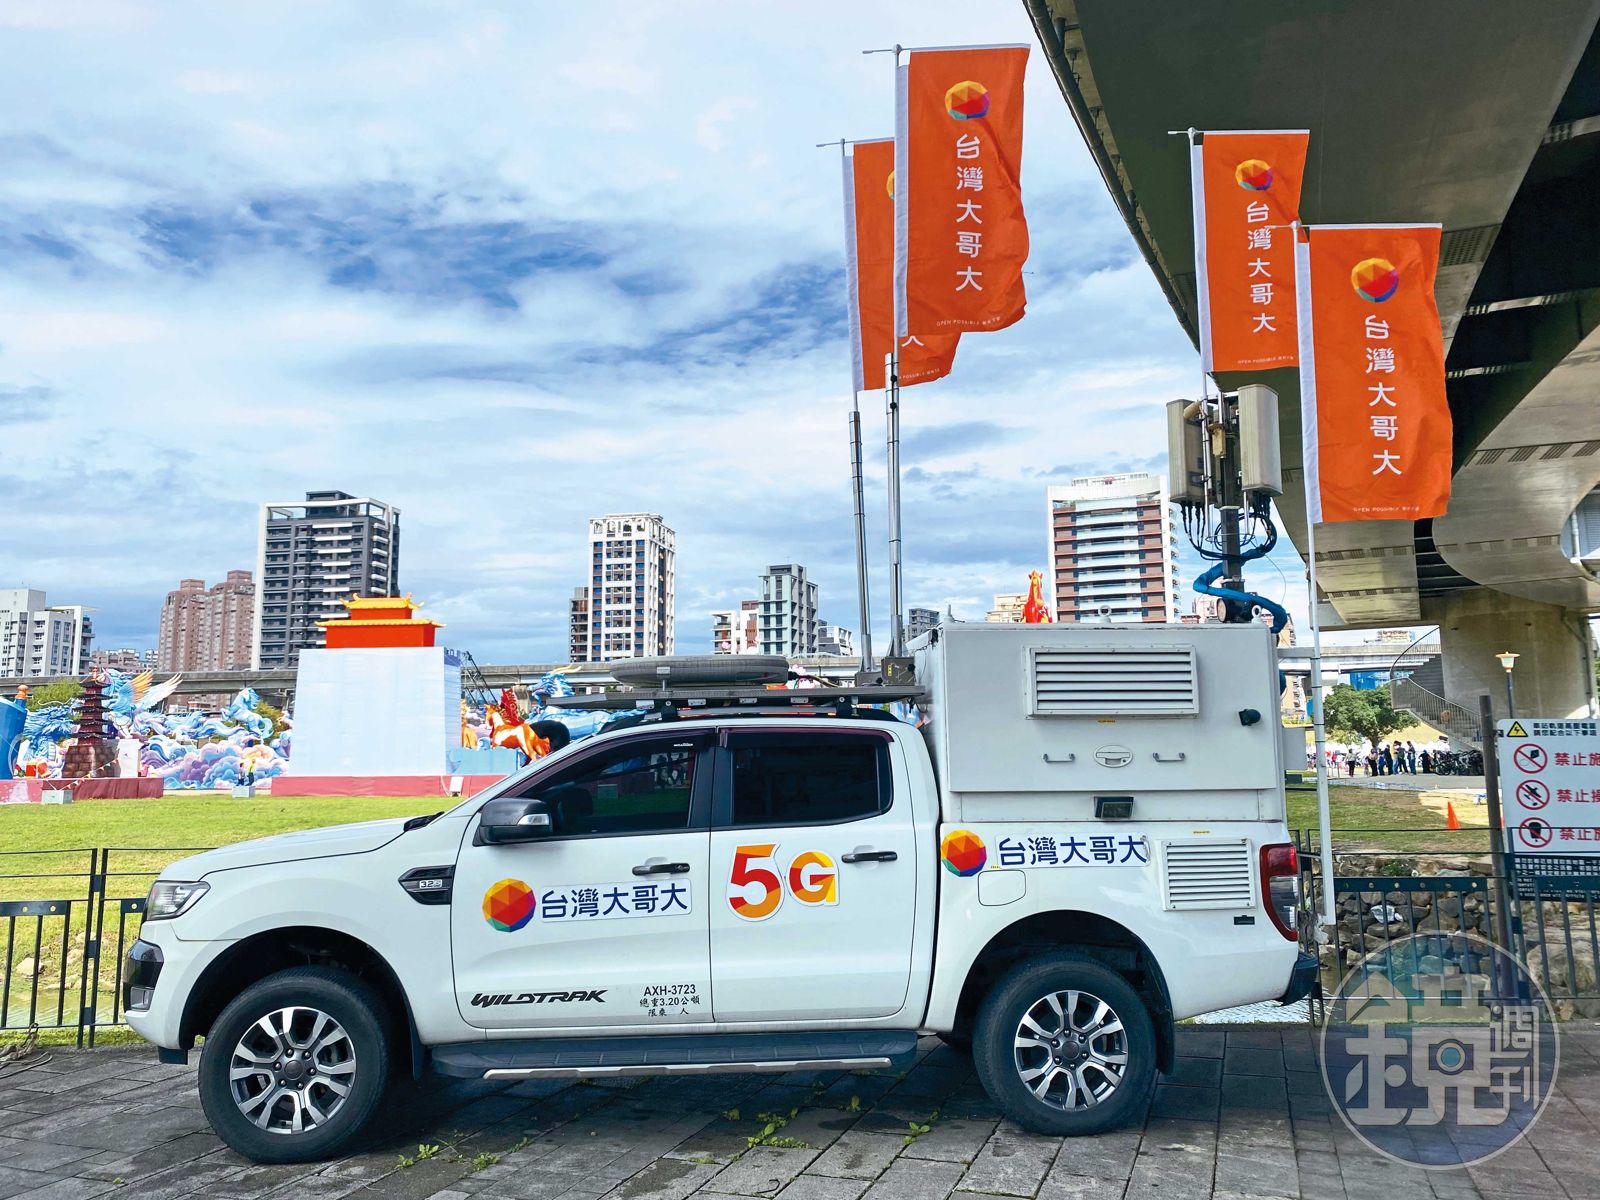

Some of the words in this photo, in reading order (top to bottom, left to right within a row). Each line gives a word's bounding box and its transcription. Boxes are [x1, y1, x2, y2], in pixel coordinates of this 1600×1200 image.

[955, 133, 984, 292] 台灣大哥大
[1246, 200, 1277, 333] 台灣大哥大
[1364, 314, 1402, 476] 台灣大哥大
[999, 836, 1147, 866] 台灣大哥大
[541, 882, 688, 919] 台灣大哥大
[729, 843, 836, 919] 5G
[470, 990, 608, 1008] WILDTRAK
[643, 984, 696, 996] AXH-3723
